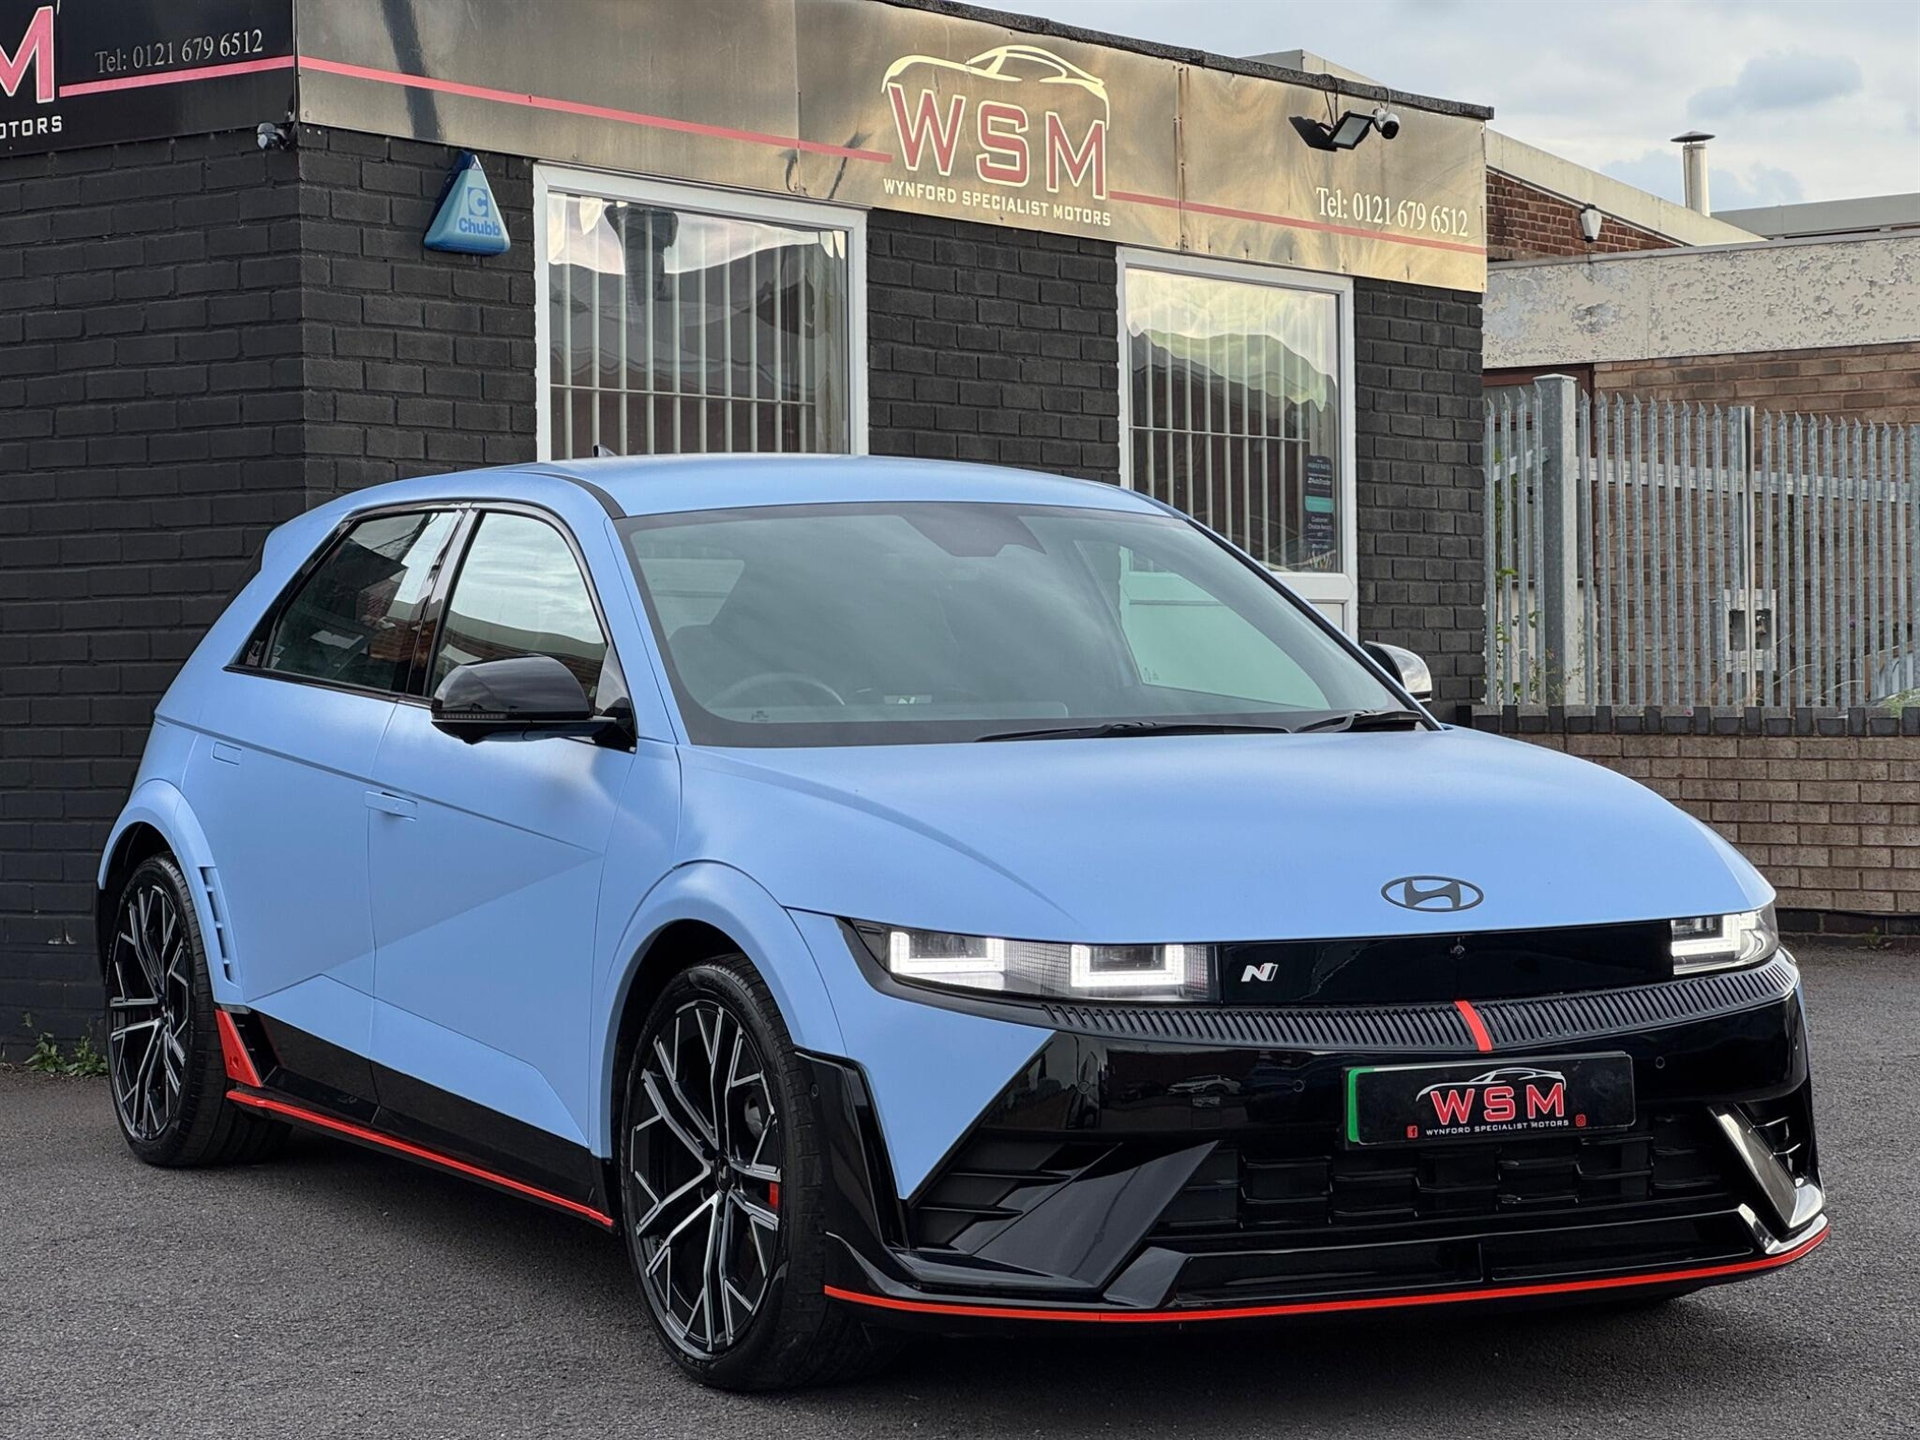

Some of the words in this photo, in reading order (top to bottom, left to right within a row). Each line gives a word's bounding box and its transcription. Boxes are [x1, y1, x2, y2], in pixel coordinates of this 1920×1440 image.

[95, 47, 128, 74] Tel:
[133, 42, 174, 69] 0121
[182, 36, 214, 62] 679
[219, 29, 264, 57] 6512
[887, 82, 1107, 200] WSM
[883, 178, 957, 203] WYNFORD
[962, 190, 1049, 217] SPECIALIST
[1053, 204, 1111, 226] MOTORS
[1315, 187, 1348, 219] Tel:
[1352, 192, 1392, 225] 0121
[1397, 199, 1427, 230] 679
[1430, 205, 1469, 237] 6512
[458, 217, 500, 236] Chubb
[1430, 1082, 1565, 1126] WSM
[1426, 1126, 1471, 1136] WYNFORD
[1474, 1122, 1529, 1133] SPECIALIST
[1531, 1119, 1570, 1128] MOTORS
